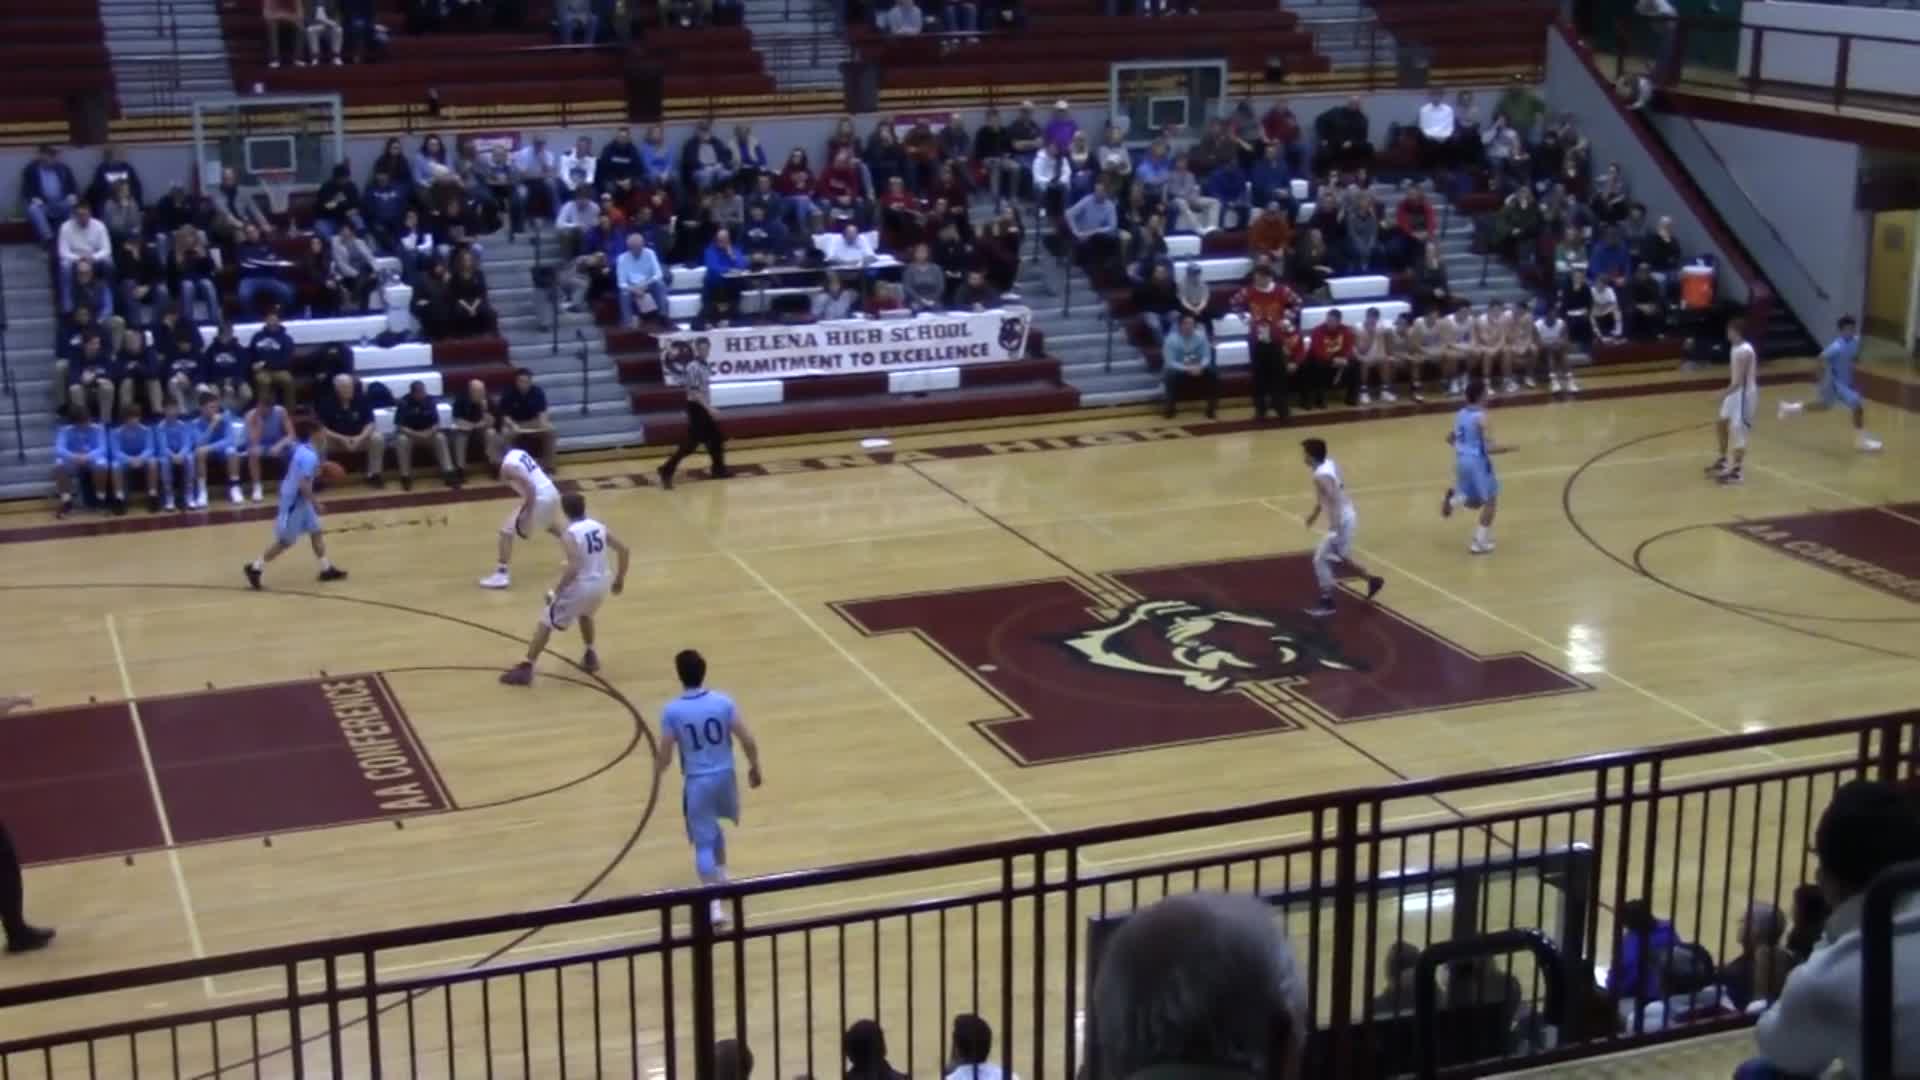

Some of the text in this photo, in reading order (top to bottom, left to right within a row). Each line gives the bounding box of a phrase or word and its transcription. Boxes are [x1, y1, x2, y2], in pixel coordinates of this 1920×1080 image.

[725, 323, 971, 352] HELENA HIGH SCHOOL
[709, 342, 989, 376] COMMITMENT TO EXCELLENCE
[982, 427, 1192, 455] HIGH
[585, 529, 604, 555] 15
[321, 679, 432, 809] AA CONFERENCE
[684, 717, 723, 751] 10
